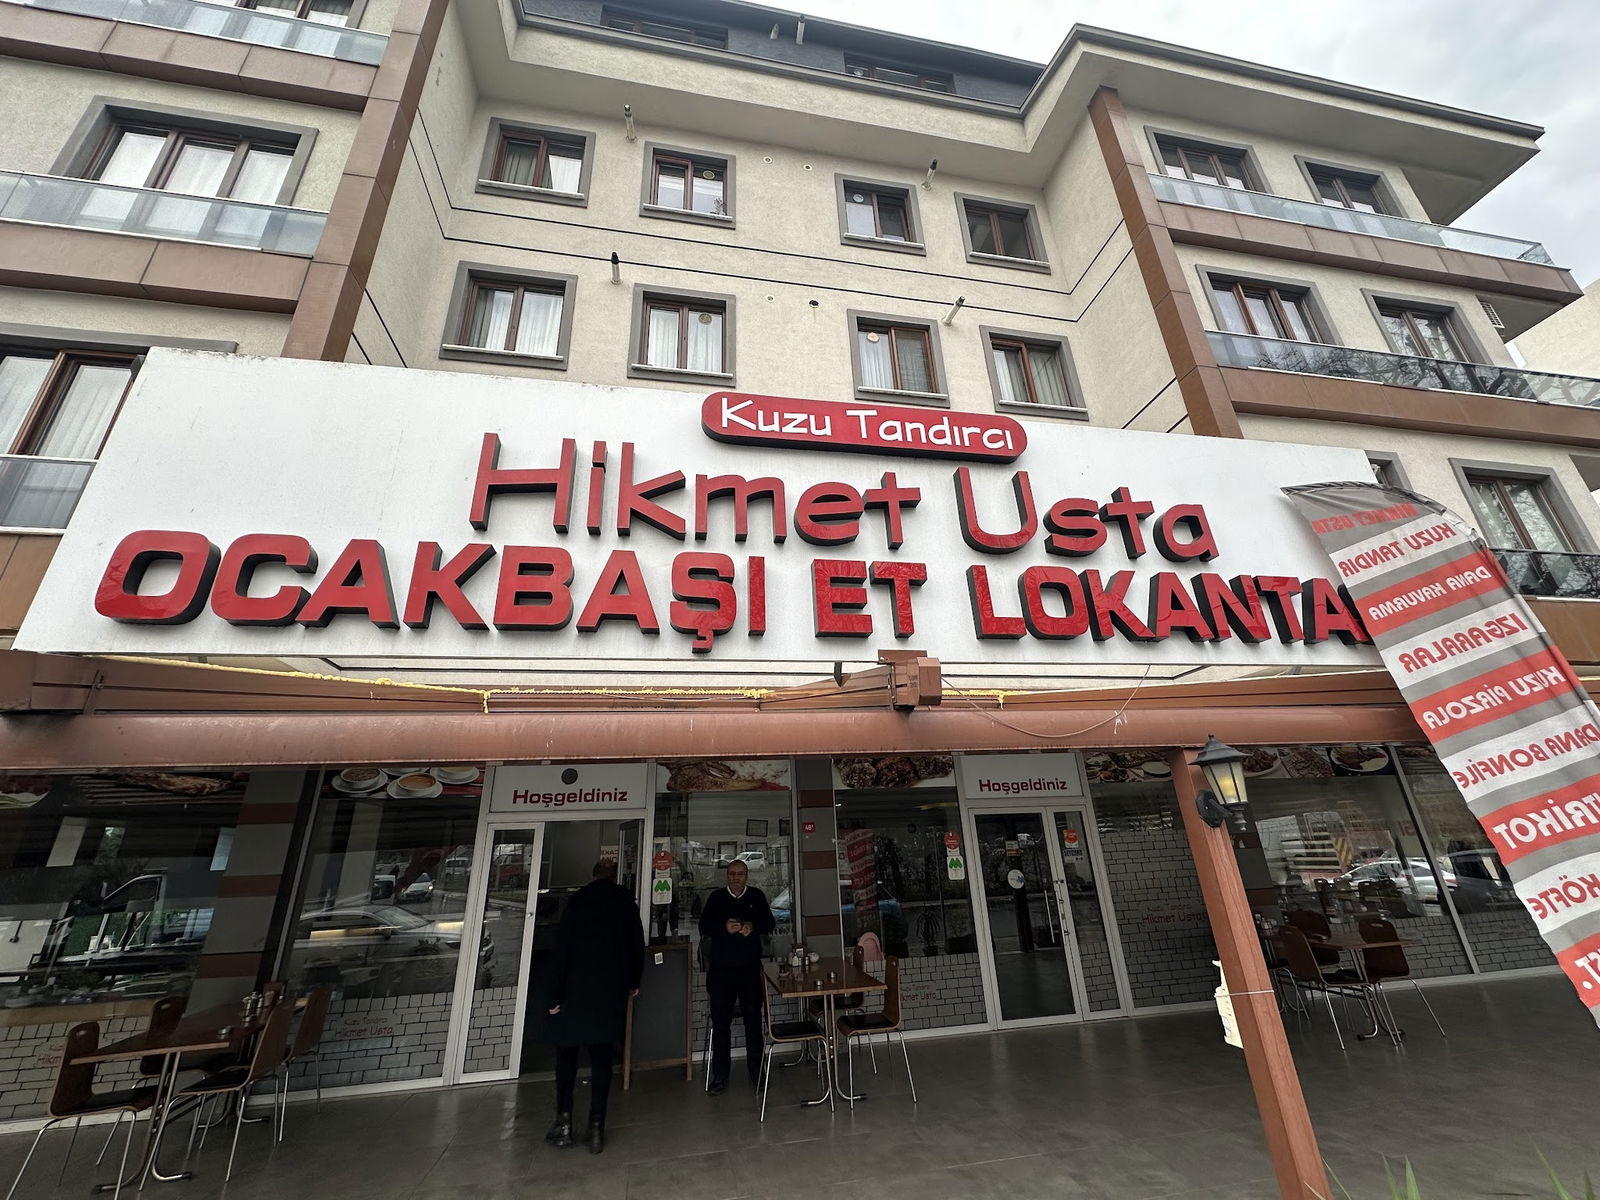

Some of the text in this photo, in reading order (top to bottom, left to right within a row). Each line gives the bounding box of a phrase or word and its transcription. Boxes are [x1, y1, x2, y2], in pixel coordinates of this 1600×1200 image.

[720, 397, 1015, 451] Kuzu Tandırcı
[469, 432, 1219, 563] Hikmet Usta
[94, 529, 1376, 653] OCAKBAŞI ET LOKANTA
[512, 788, 628, 808] Hoşgeldiniz
[978, 778, 1068, 795] Hoşgeldiniz
